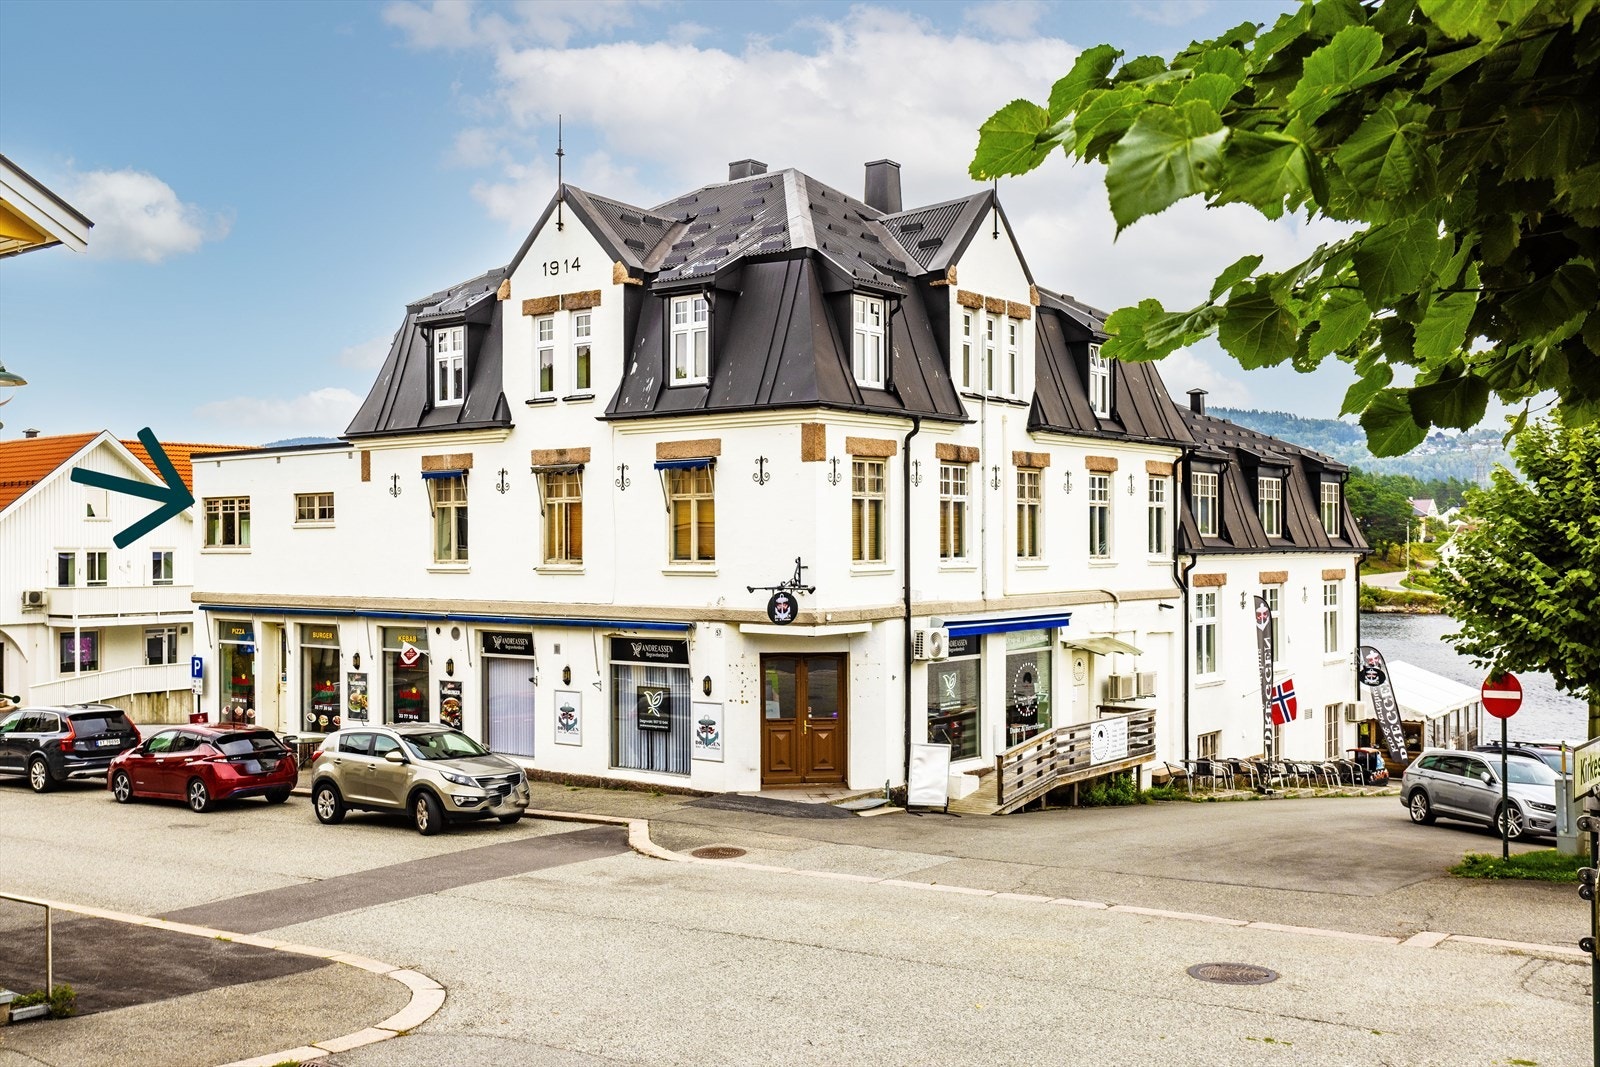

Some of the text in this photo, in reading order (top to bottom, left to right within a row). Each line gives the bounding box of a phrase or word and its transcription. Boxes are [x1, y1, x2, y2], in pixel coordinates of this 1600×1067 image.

[542, 256, 581, 276] 1914
[312, 631, 333, 639] BURGER
[397, 635, 417, 643] KEBAB
[502, 637, 529, 646] ANDREASSEN
[642, 644, 673, 653] ANDREASSEN
[194, 659, 201, 676] P
